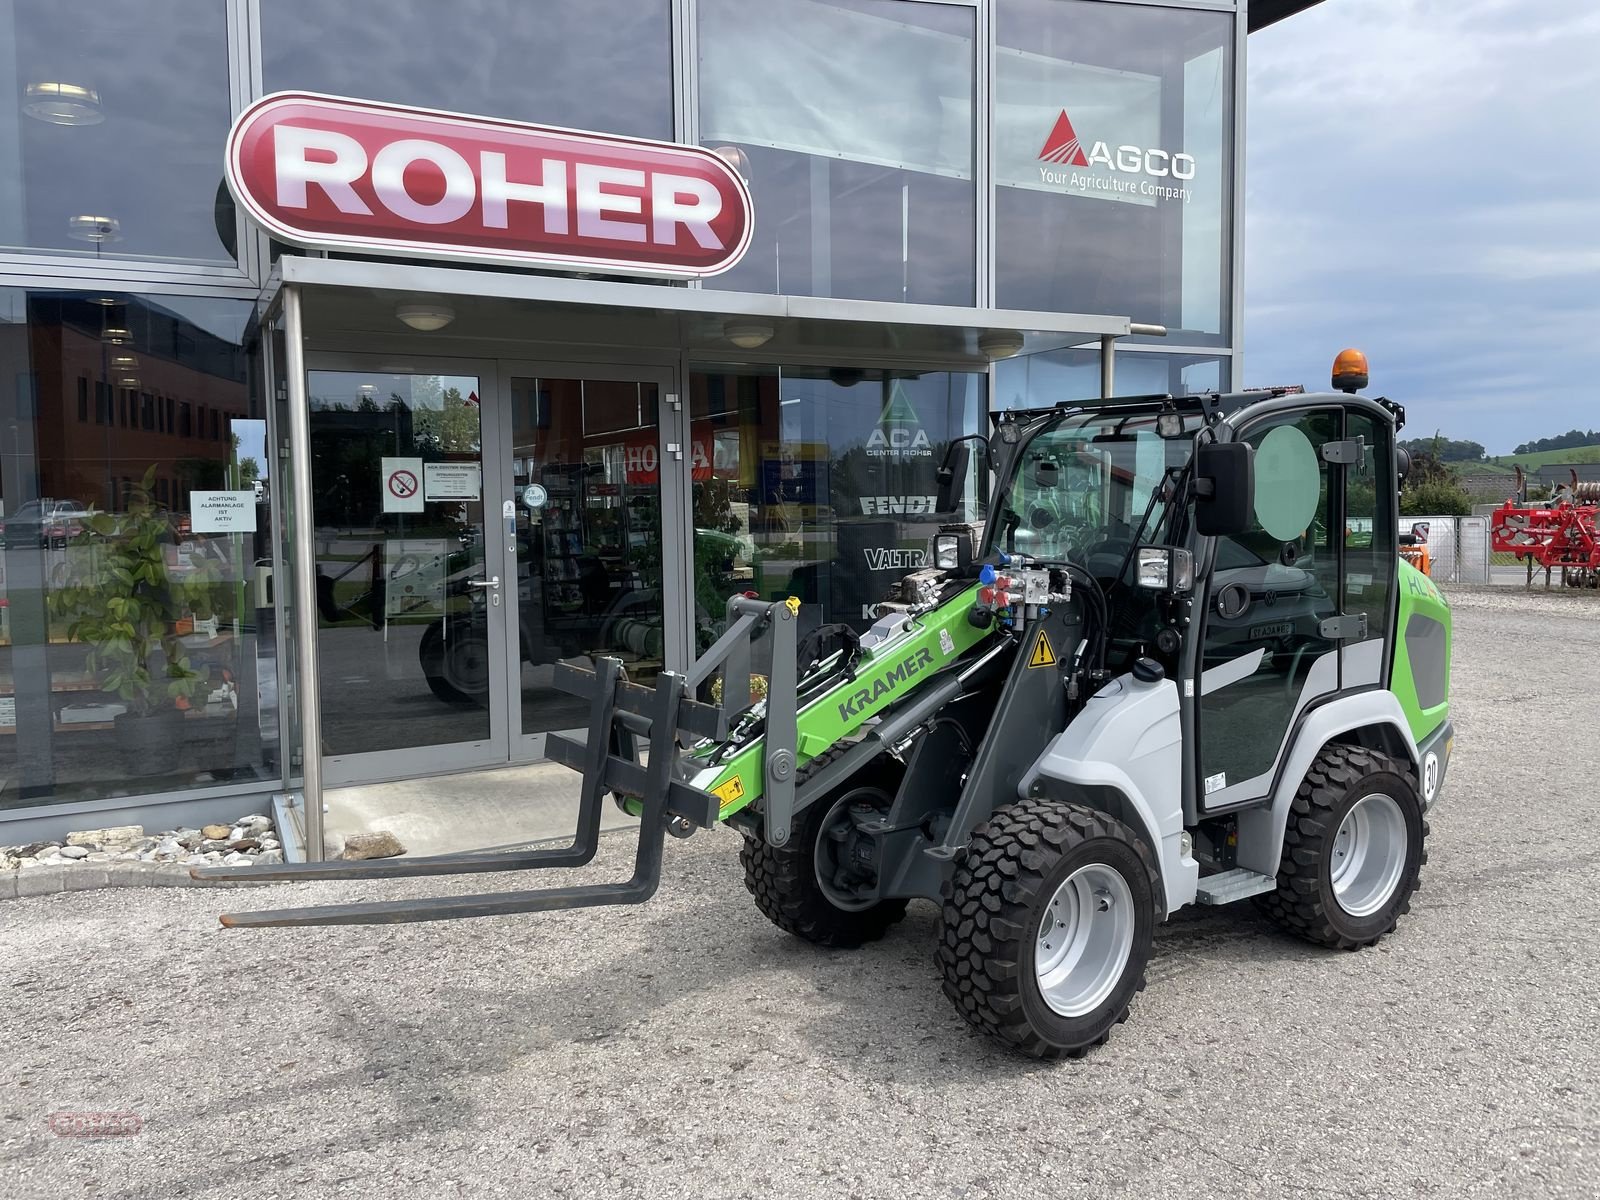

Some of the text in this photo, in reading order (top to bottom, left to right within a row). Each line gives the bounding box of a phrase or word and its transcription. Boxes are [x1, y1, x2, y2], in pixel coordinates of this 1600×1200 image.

[1089, 141, 1195, 180] AGCO
[273, 123, 726, 251] ROHER
[1039, 167, 1193, 203] Your Agriculture Company
[866, 429, 931, 448] ACA
[860, 496, 938, 515] FENDT
[838, 647, 934, 722] KRAMER
[1427, 760, 1436, 794] 30
